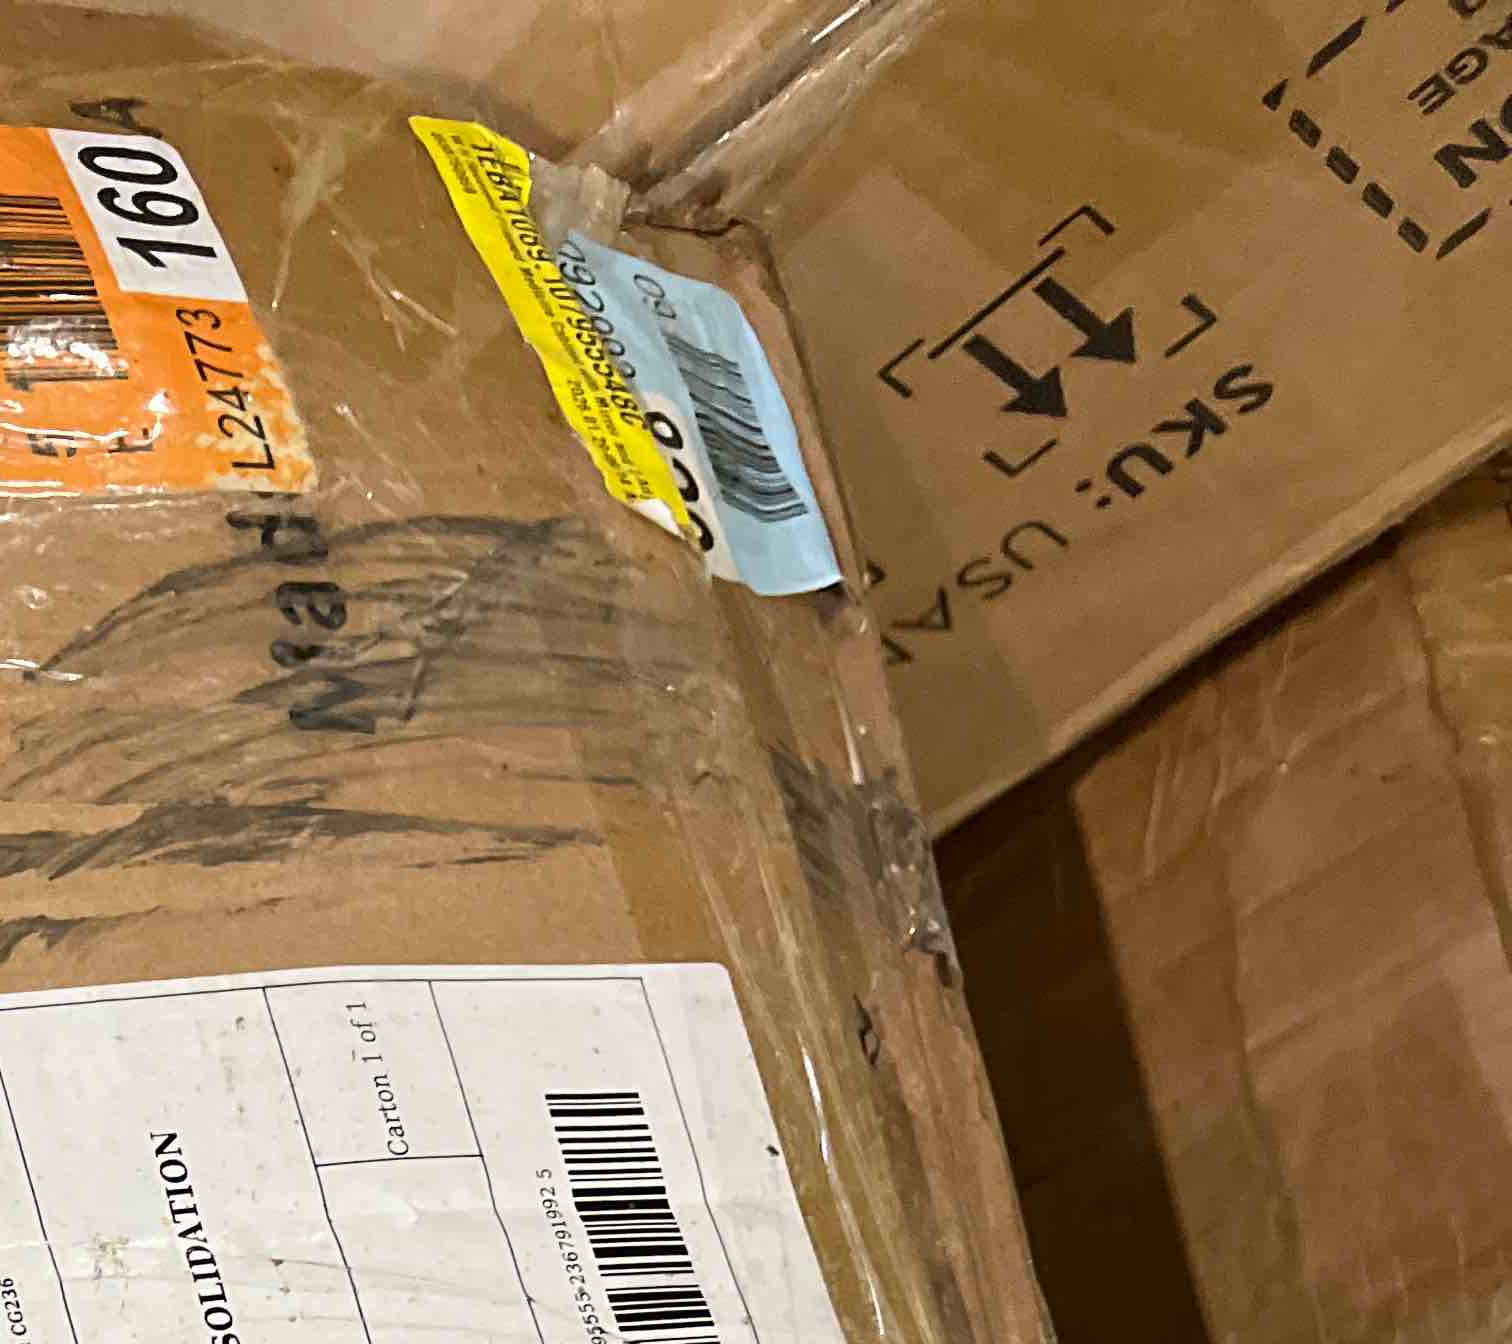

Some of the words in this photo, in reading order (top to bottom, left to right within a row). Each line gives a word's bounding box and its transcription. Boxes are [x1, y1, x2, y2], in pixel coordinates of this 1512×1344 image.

[77, 146, 218, 268] 160
[176, 308, 276, 470] L24773
[1074, 364, 1274, 510] SKU:
[345, 1001, 368, 1013] 1
[350, 1019, 377, 1043] of
[361, 1053, 384, 1063] 1
[374, 1074, 409, 1156] Carton
[535, 1168, 553, 1180] 5
